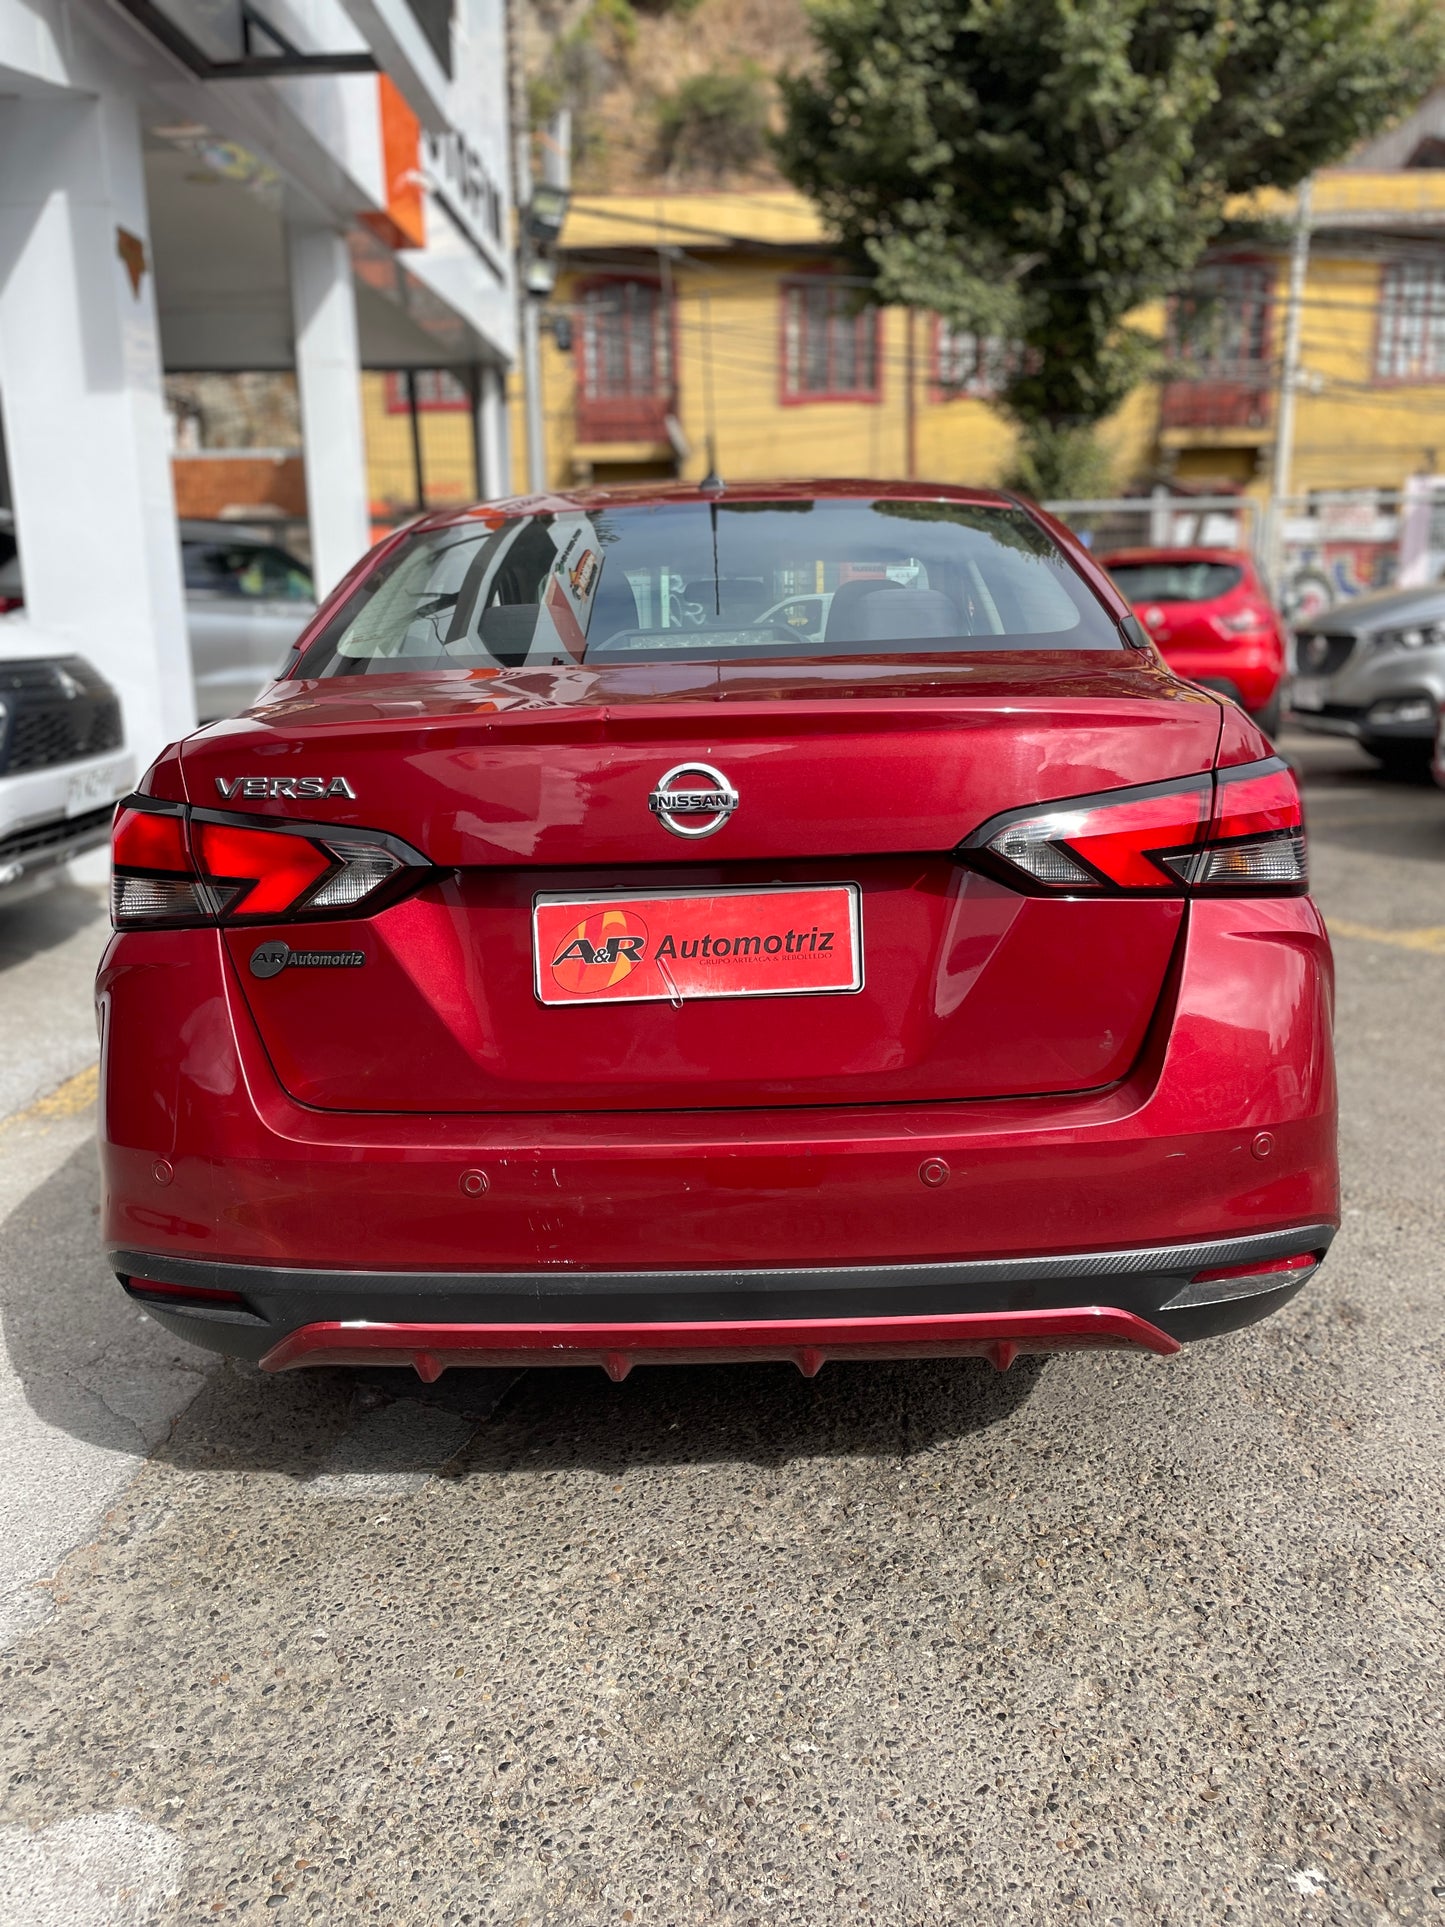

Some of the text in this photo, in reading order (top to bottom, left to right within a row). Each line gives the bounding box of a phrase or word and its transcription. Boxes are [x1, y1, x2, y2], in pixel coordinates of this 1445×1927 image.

[215, 777, 356, 799] VERSA
[658, 795, 729, 808] NISSAN
[551, 927, 835, 967] A&R Automotriz
[288, 953, 362, 965] Automotriz
[699, 957, 731, 966] GRUPO
[733, 955, 772, 964] ARTEAGA
